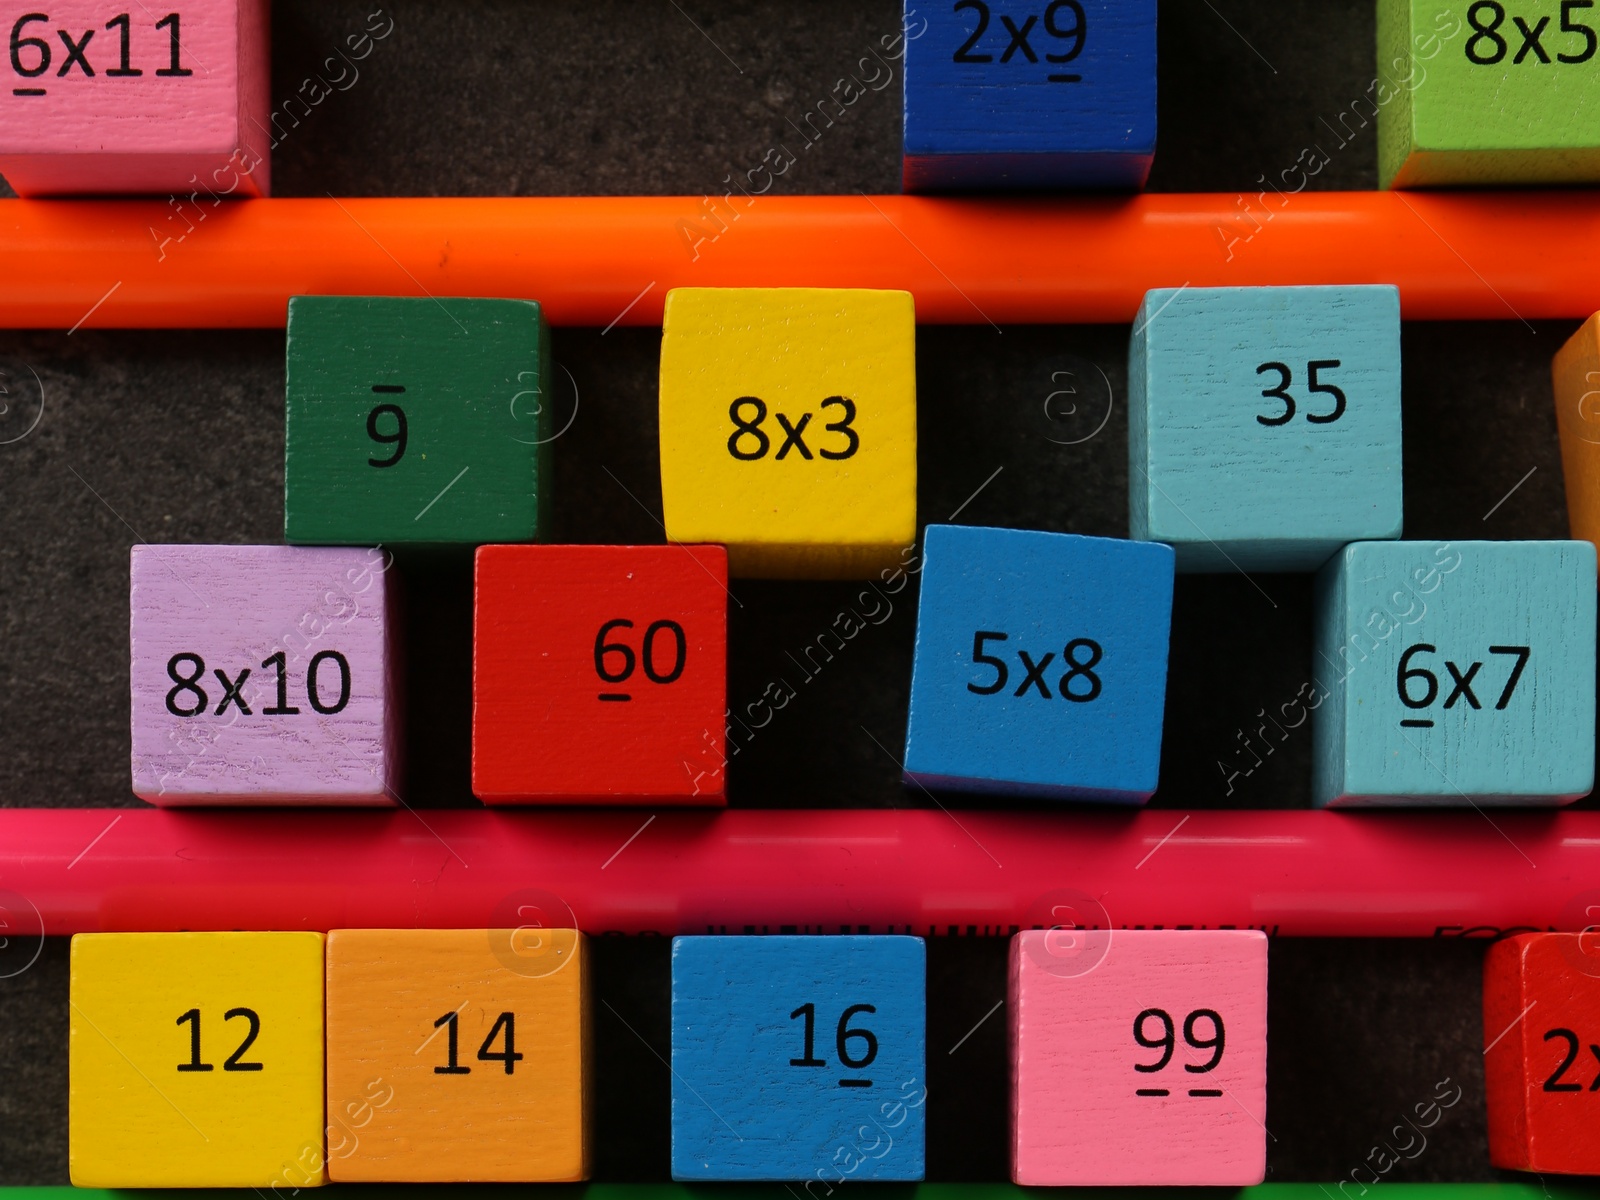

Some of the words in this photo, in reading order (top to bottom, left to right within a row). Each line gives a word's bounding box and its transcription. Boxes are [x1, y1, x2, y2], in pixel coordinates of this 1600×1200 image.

[10, 13, 193, 78] 6x11
[953, 0, 1087, 64] 2x9
[1464, 0, 1598, 65] 8x5
[1255, 360, 1347, 426] 35
[728, 396, 860, 461] 8x3
[165, 650, 351, 717] 8x10
[594, 619, 687, 684] 60
[967, 631, 1103, 702] 5x8
[1397, 643, 1531, 710] 6x7
[176, 1008, 263, 1071] 12
[433, 1012, 523, 1075] 14
[788, 1004, 879, 1068] 16
[1133, 1008, 1225, 1073] 99
